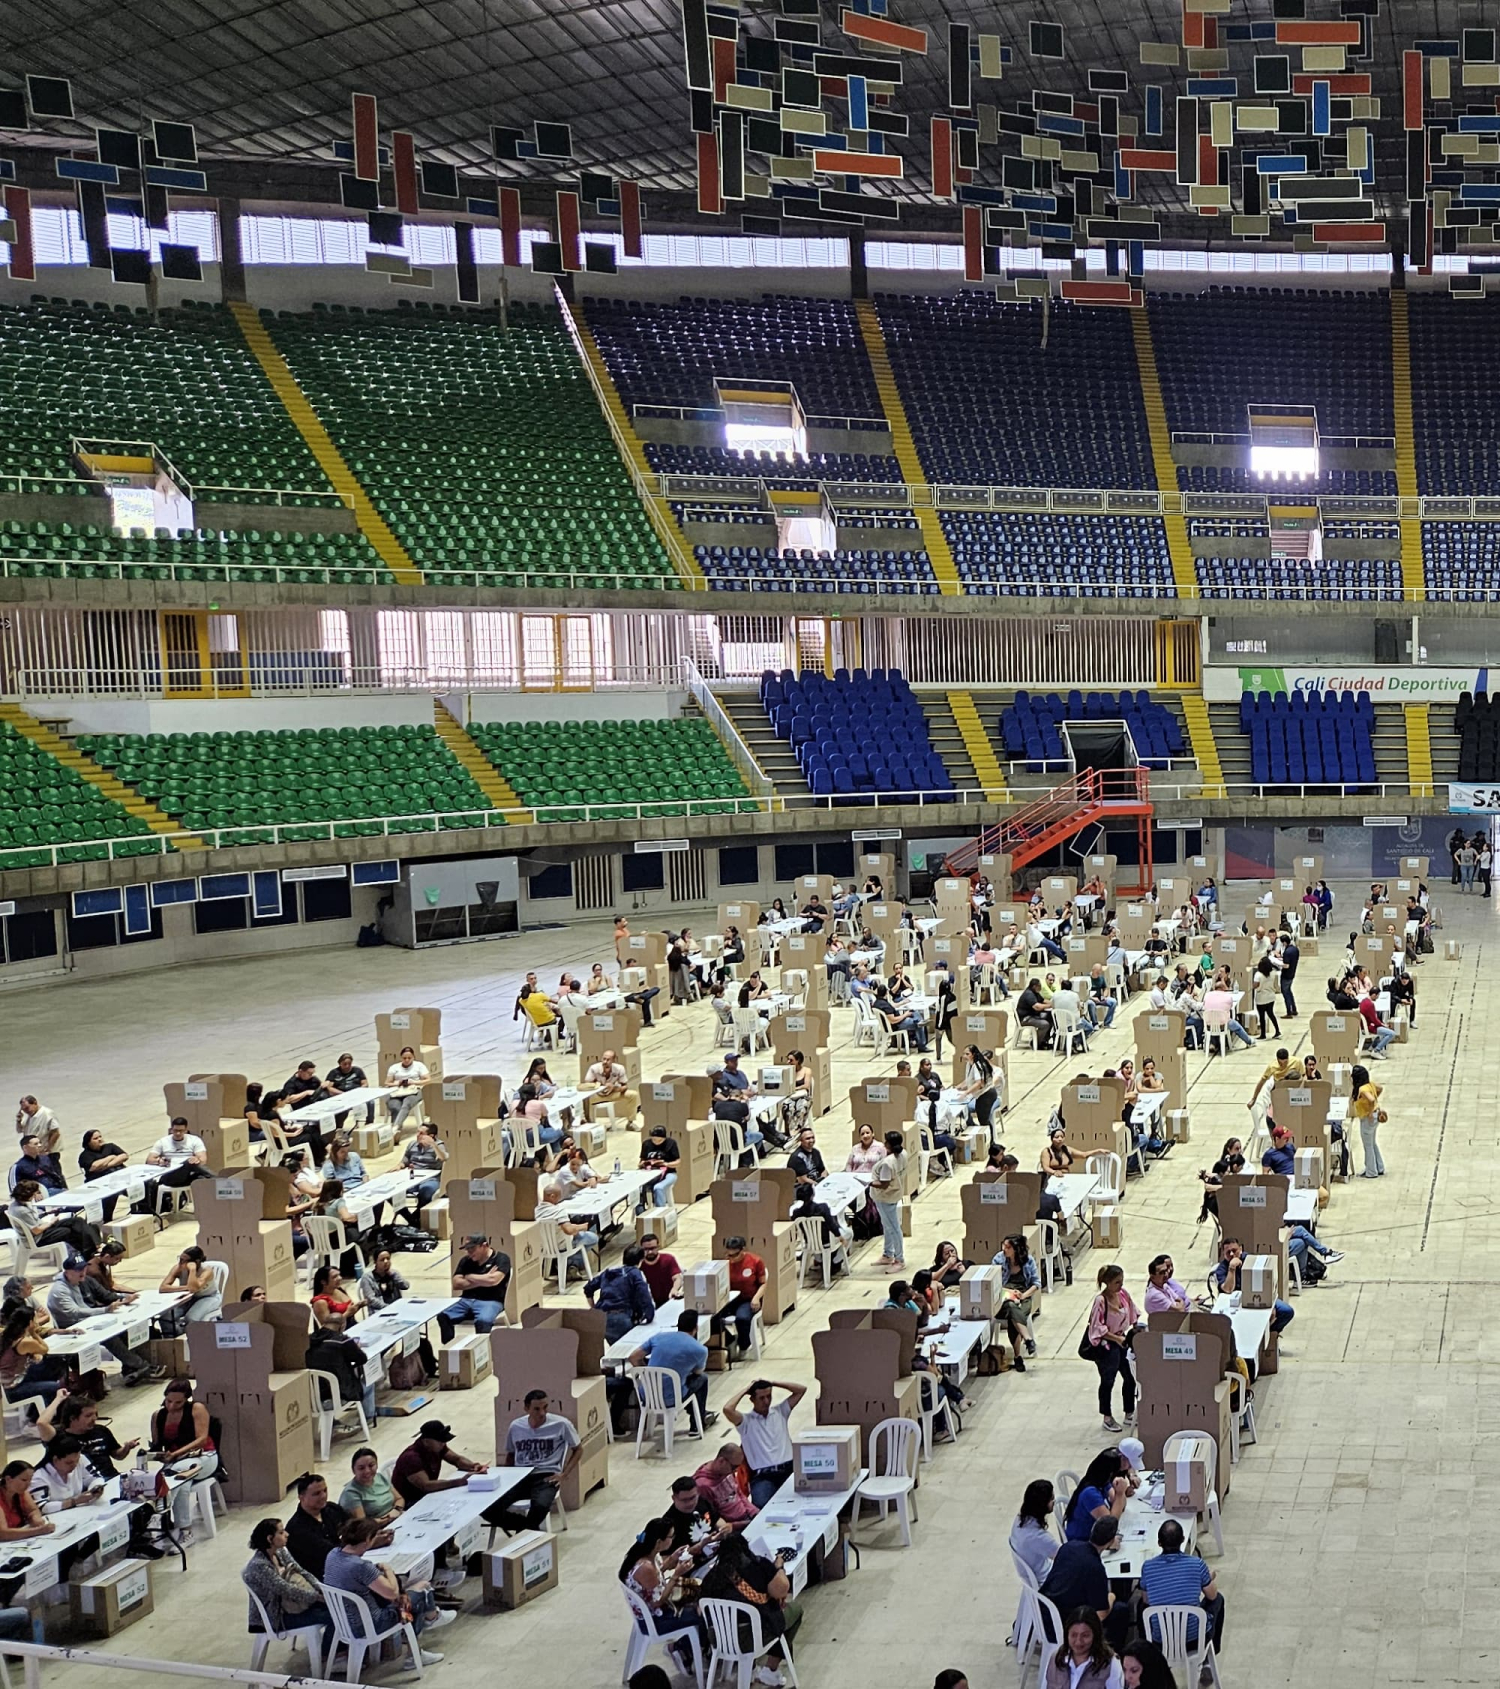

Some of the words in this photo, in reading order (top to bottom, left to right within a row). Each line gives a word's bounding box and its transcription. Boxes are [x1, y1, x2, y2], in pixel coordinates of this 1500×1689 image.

[1294, 677, 1325, 691] Cali
[1328, 677, 1385, 691] Ciudad
[1388, 677, 1468, 693] Deportiva
[237, 1335, 247, 1343] 52
[1184, 1347, 1194, 1355] 49
[803, 1460, 823, 1468] MESA
[101, 1536, 117, 1549] MESA
[119, 1530, 127, 1540] 52
[525, 1564, 541, 1578] MESA
[542, 1558, 550, 1569] 51
[119, 1591, 135, 1603] MESA
[136, 1583, 145, 1593] 52
